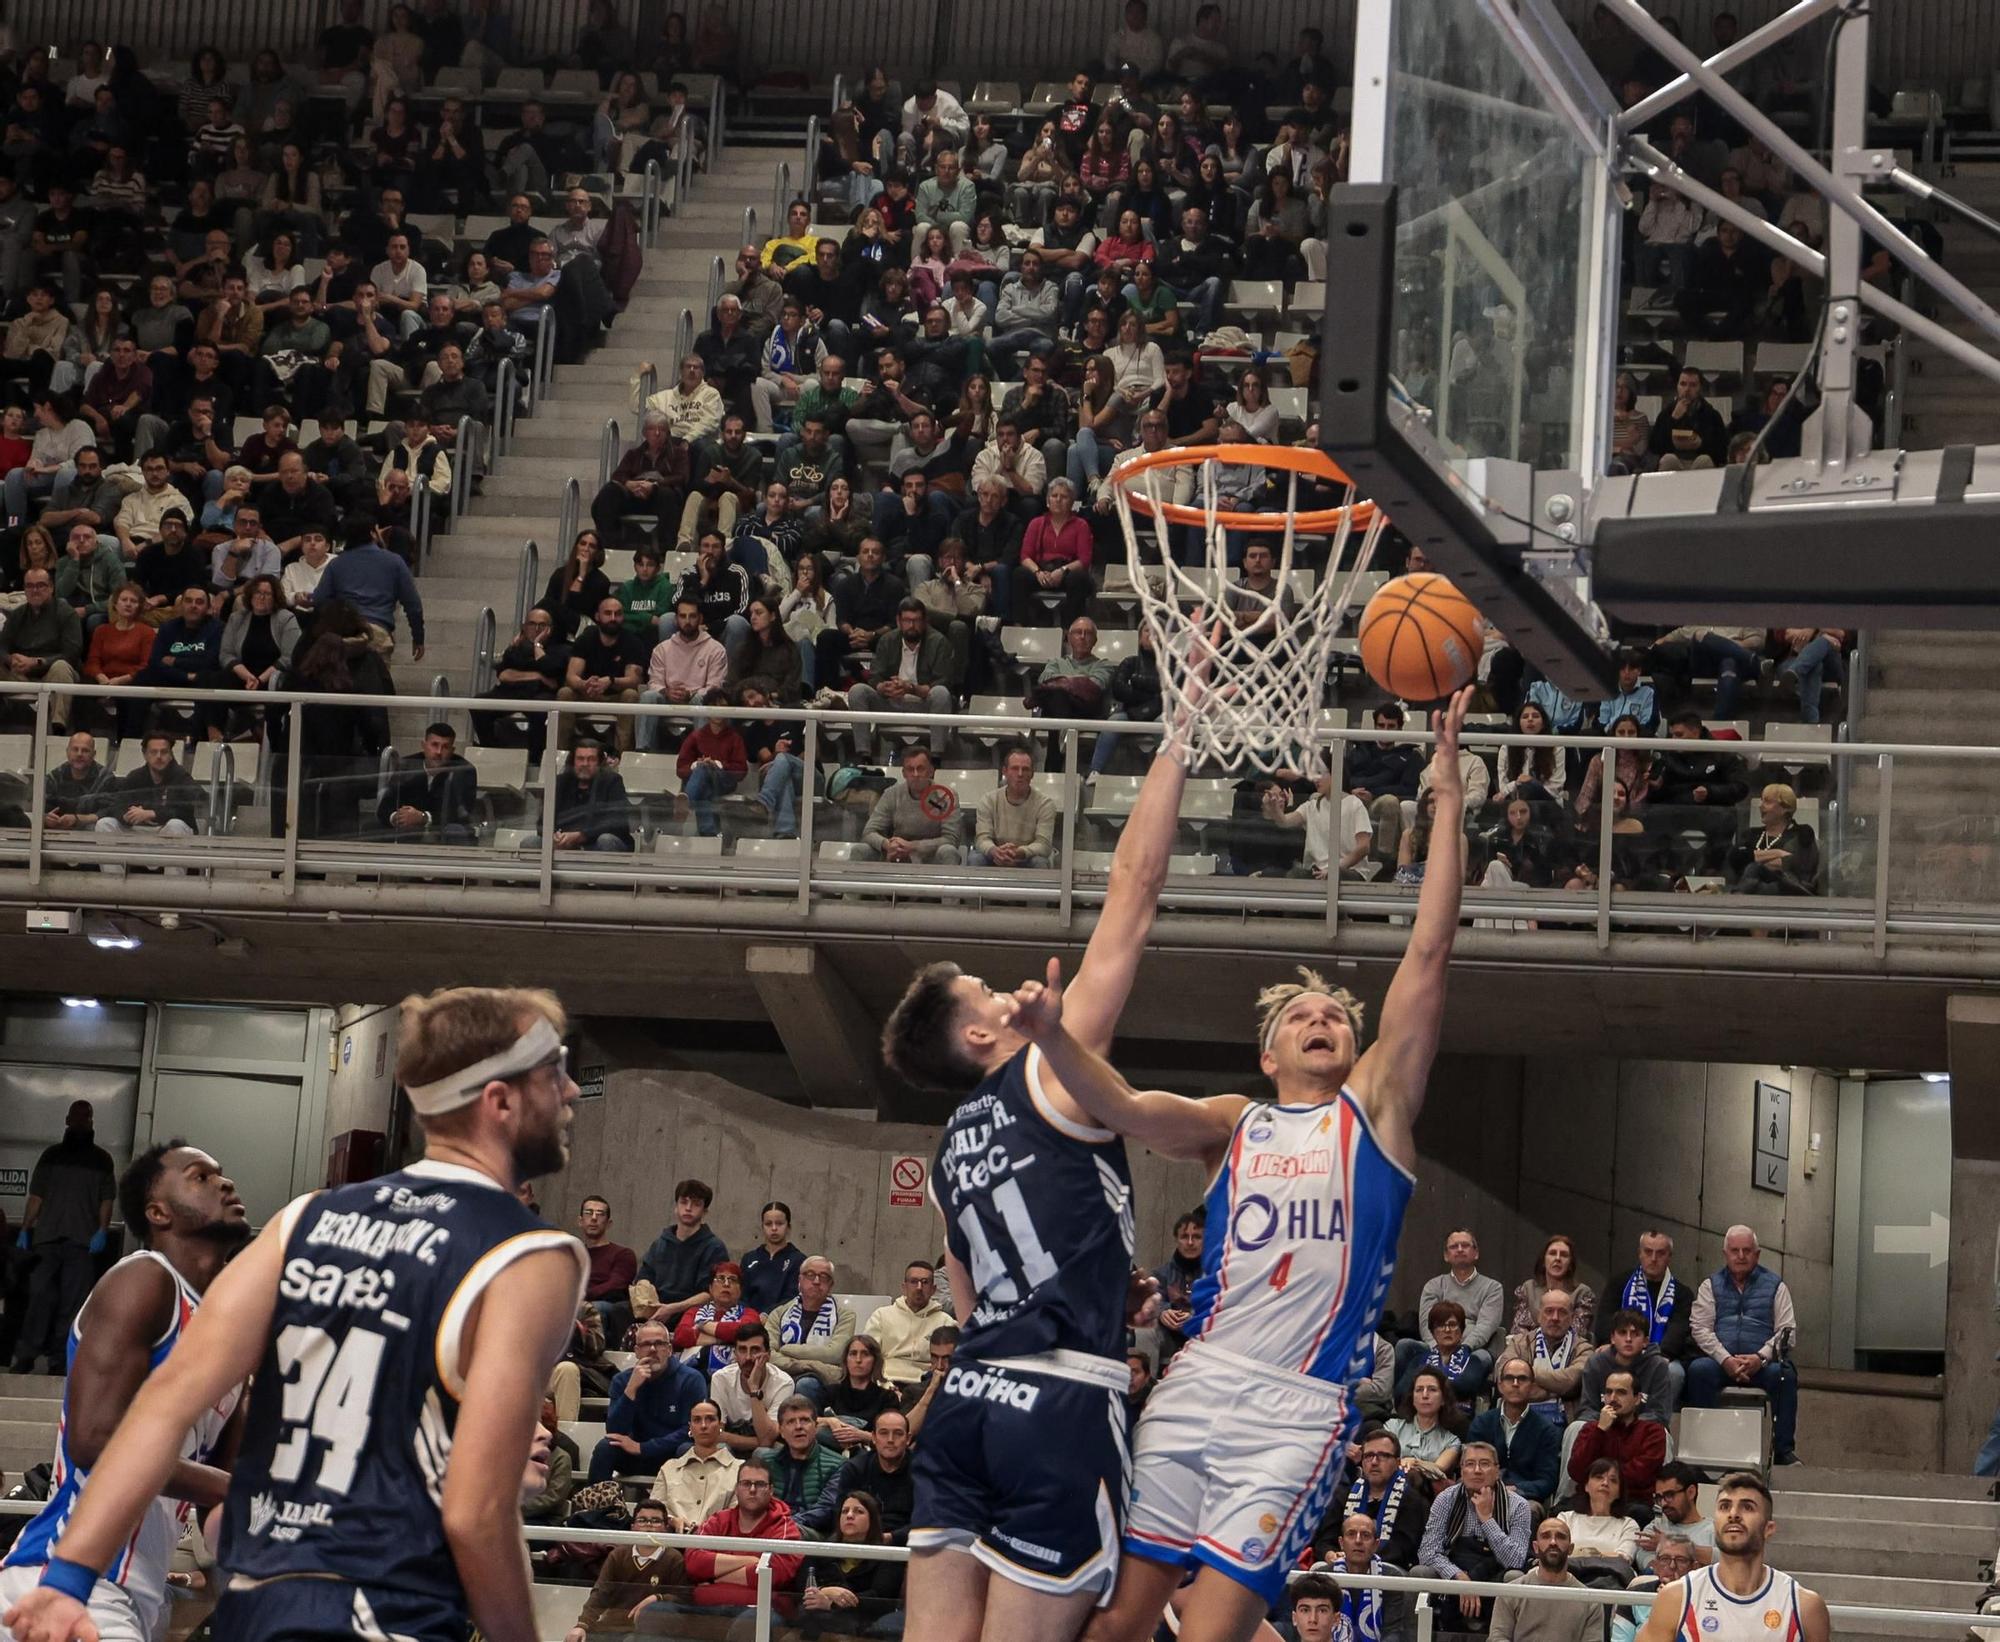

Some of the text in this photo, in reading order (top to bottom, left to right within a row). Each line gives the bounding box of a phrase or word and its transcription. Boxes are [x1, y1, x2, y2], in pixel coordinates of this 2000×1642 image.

[1770, 1092, 1781, 1104] WC
[957, 1177, 1059, 1303] 41
[1288, 1199, 1346, 1242] HLA
[1269, 1252, 1293, 1291] 4
